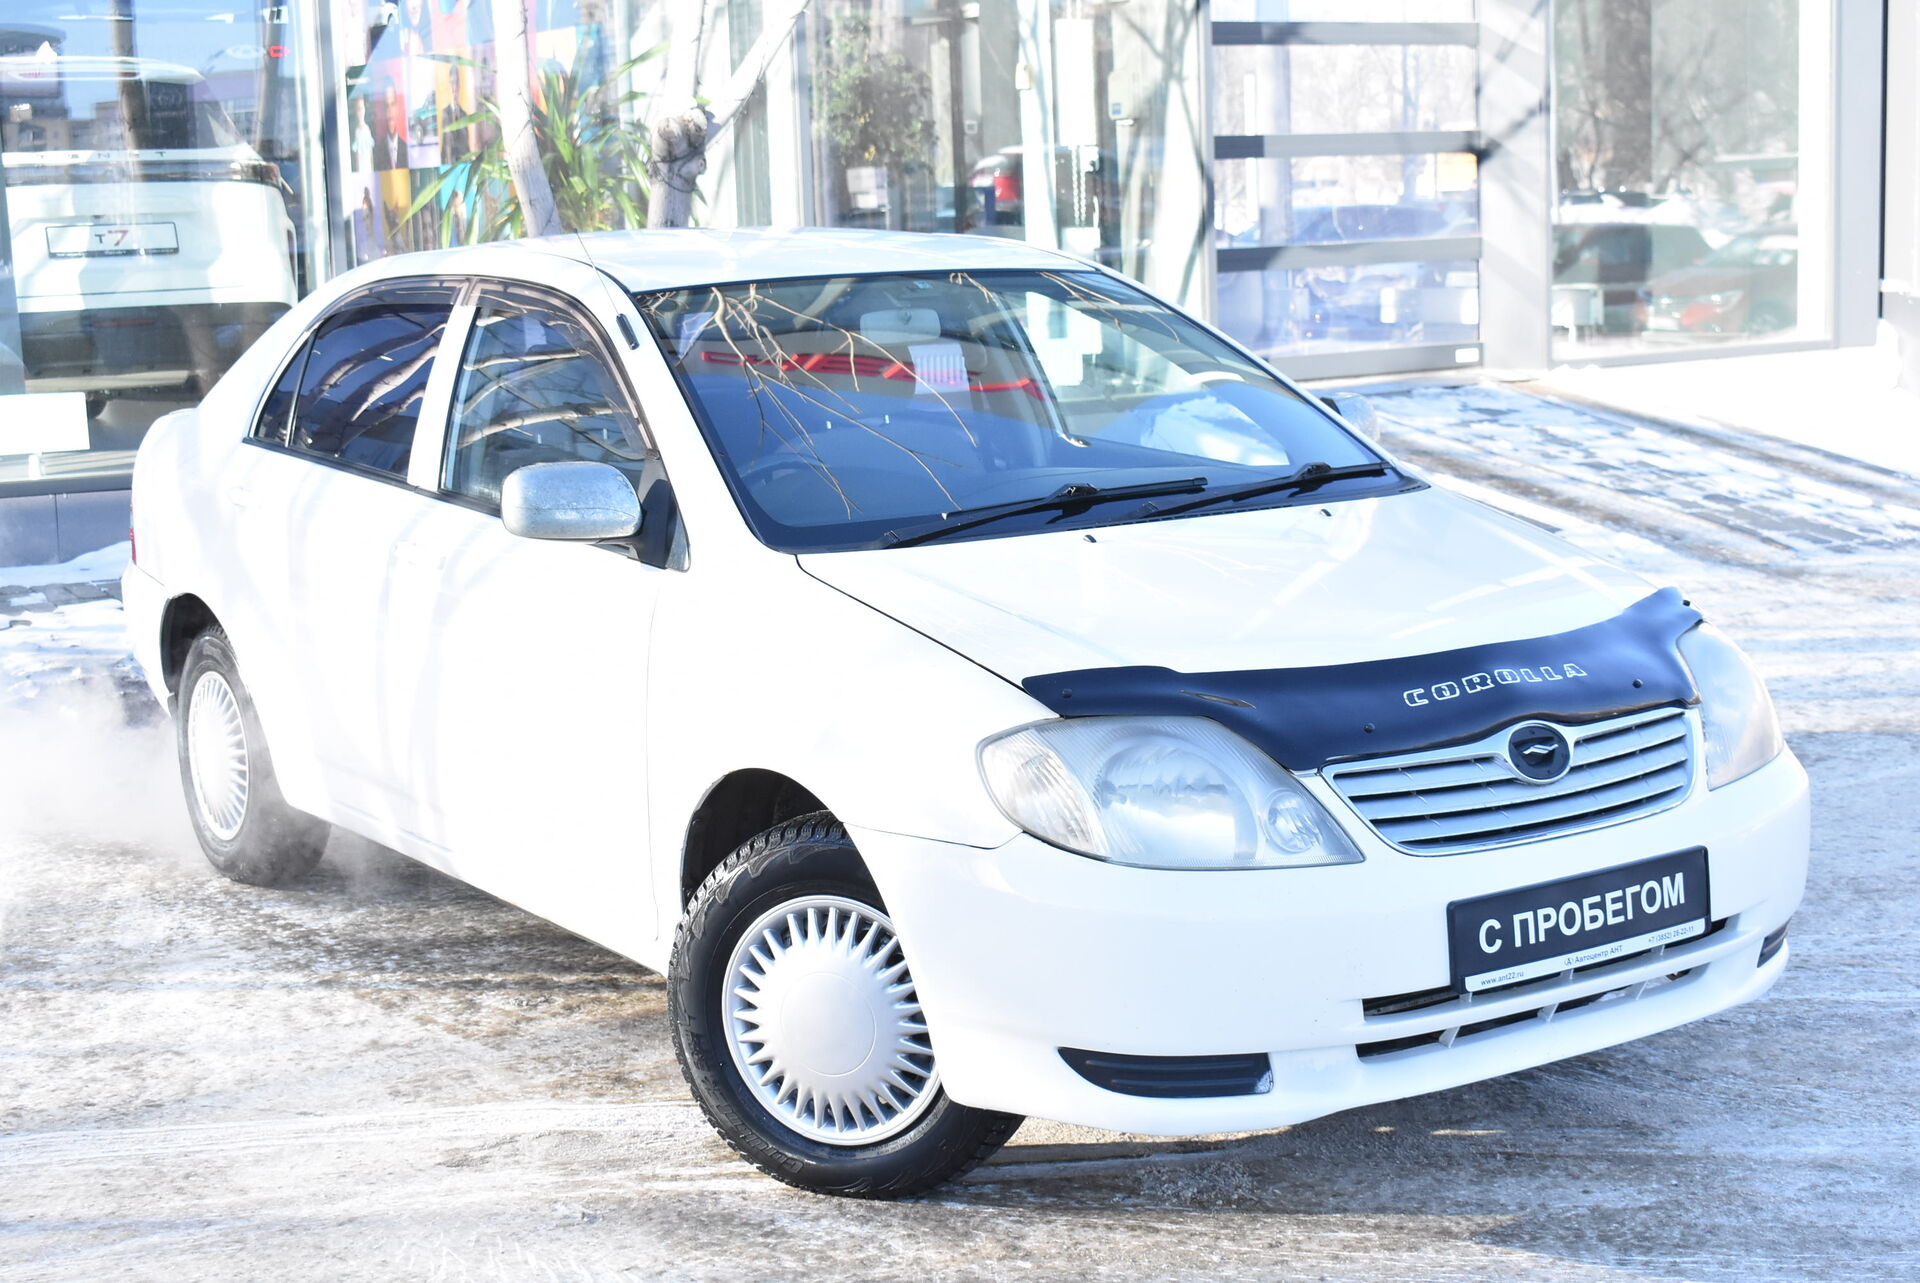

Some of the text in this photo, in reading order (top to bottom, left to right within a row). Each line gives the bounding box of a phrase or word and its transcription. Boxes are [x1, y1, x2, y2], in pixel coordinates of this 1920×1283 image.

[1403, 663, 1587, 707] COROLLA
[1479, 872, 1685, 954] С ПРОБЕГОМ
[1575, 949, 1609, 964] Автоцентр
[1481, 970, 1524, 986] www.ant22.ru
